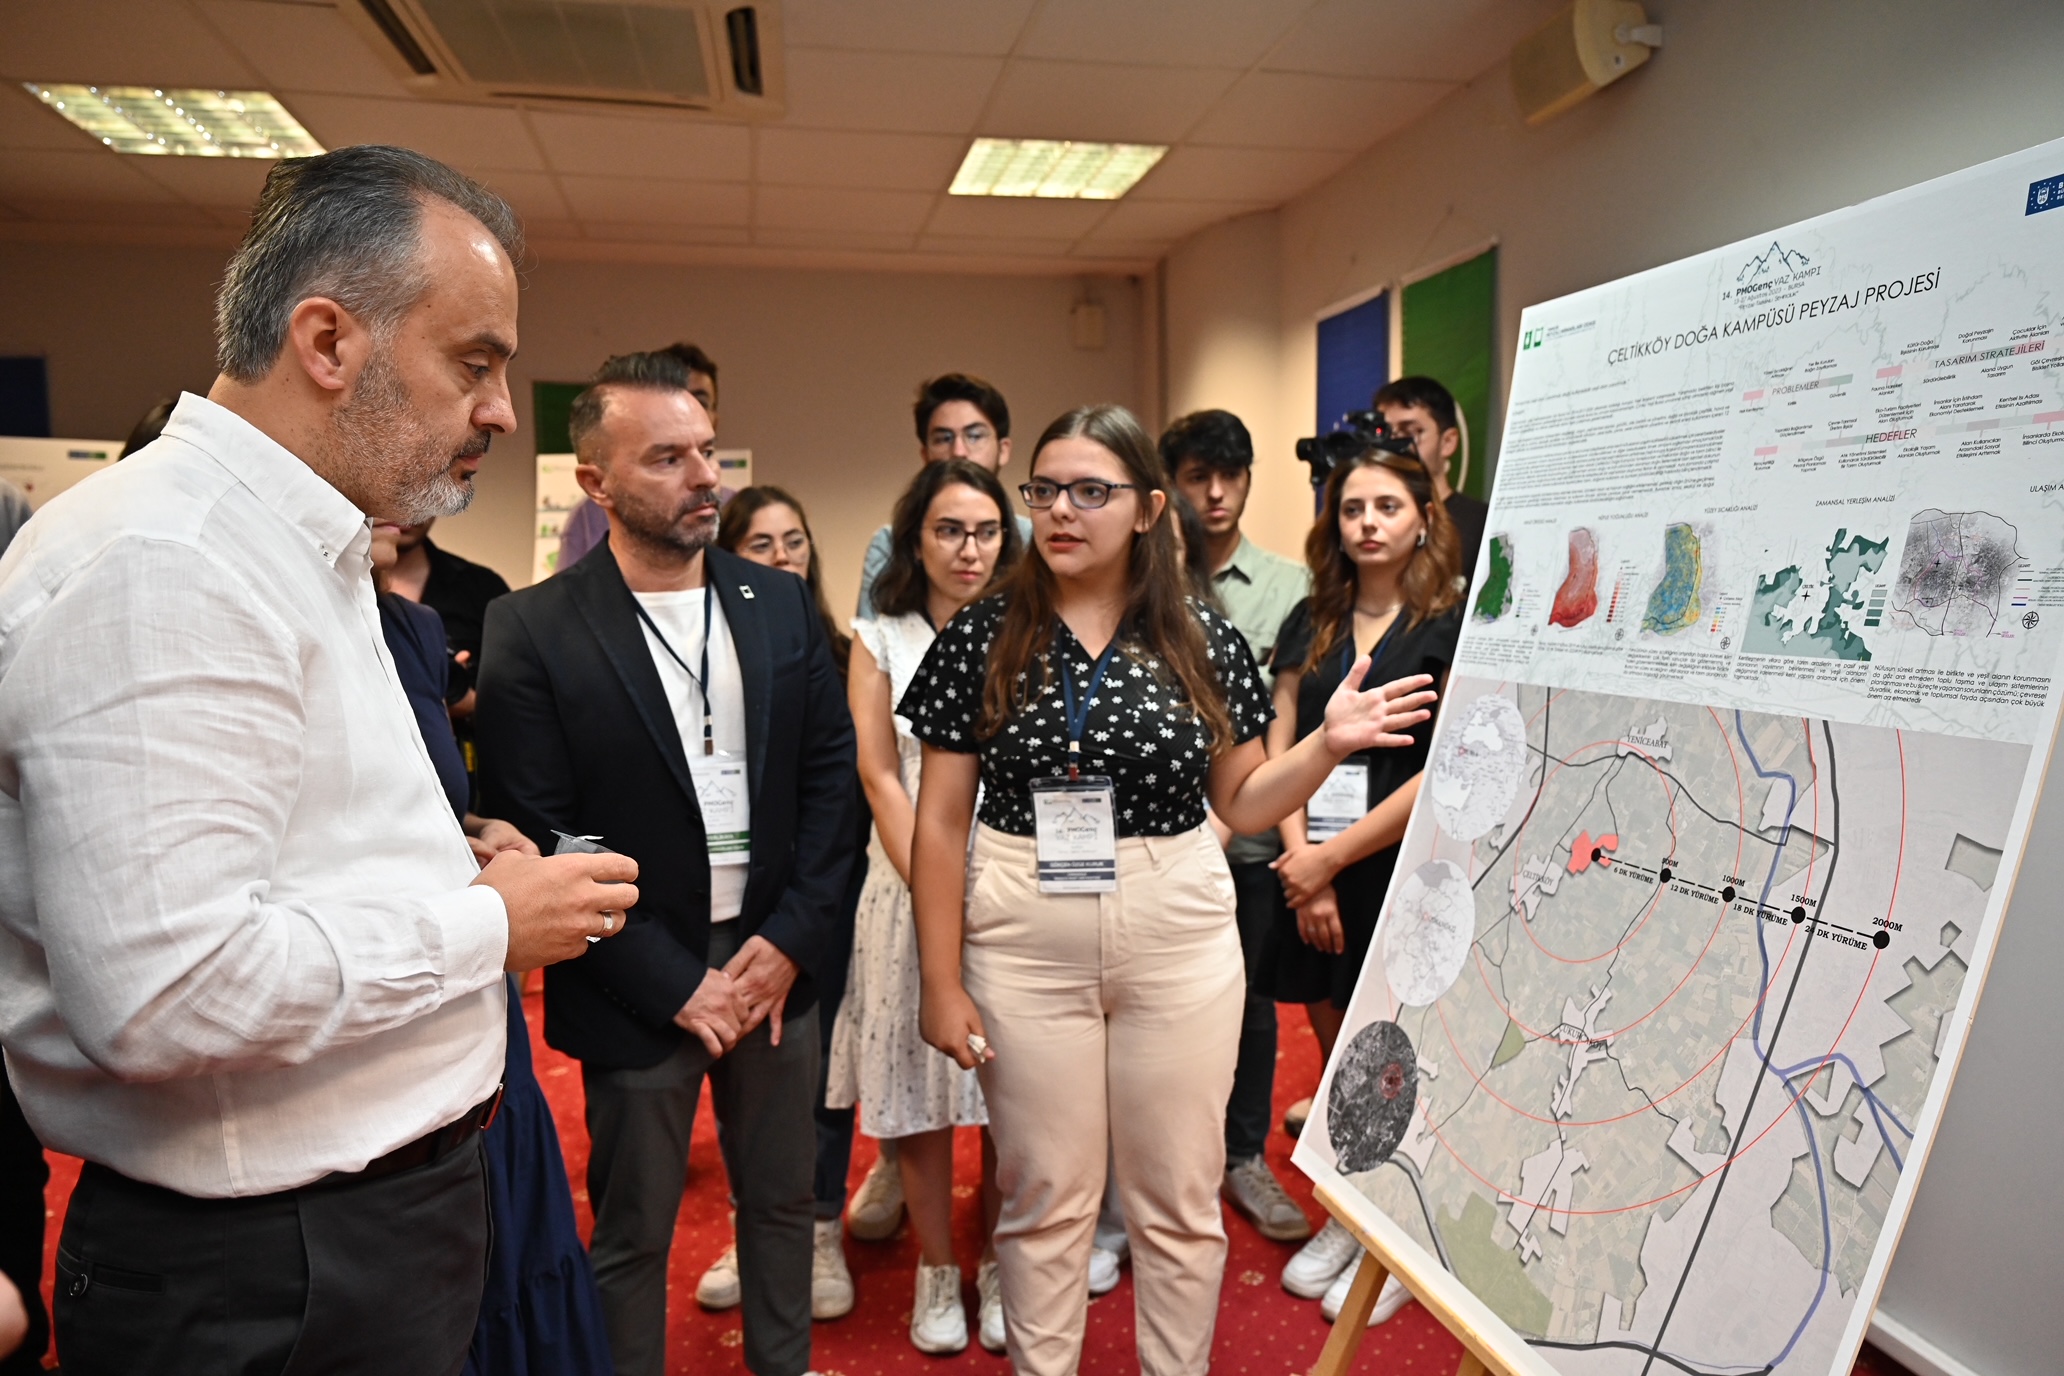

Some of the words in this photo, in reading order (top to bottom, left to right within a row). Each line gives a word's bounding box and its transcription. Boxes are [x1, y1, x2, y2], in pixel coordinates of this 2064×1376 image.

[1722, 291, 1732, 300] 14.
[1736, 281, 1773, 296] PMOGenç
[1793, 266, 1821, 281] KAMPI
[1607, 334, 1671, 366] ÇELTİKKÖY
[1674, 324, 1718, 350] DOĞA
[1722, 303, 1796, 338] KAMPÜSÜ
[1799, 290, 1861, 320] PEYZAJ
[1864, 266, 1942, 305] PROJESİ
[1934, 355, 1977, 368] TASARIM
[1979, 340, 2046, 361] STRATEJİLERİ
[1772, 381, 1819, 395] PROBLEMLER
[1865, 428, 1917, 444] HEDEFLER
[1815, 498, 1844, 507] ZAMANSAL
[1846, 496, 1871, 505] YERLEŞİM
[1872, 494, 1896, 503] ANALİZİ
[1618, 868, 1628, 877] DK
[1628, 871, 1654, 884] YÜRÜME
[1722, 875, 1746, 887] 1000M
[1680, 886, 1690, 895] DK
[1691, 889, 1719, 905] YÜRÜME
[1791, 894, 1817, 908] 1500M
[1743, 906, 1755, 916] DK
[1756, 910, 1788, 926] YÜRÜME
[1872, 917, 1903, 932] 2000M
[1804, 926, 1815, 934] 24
[1816, 929, 1830, 939] DK
[1831, 933, 1868, 950] YÜRÜME
